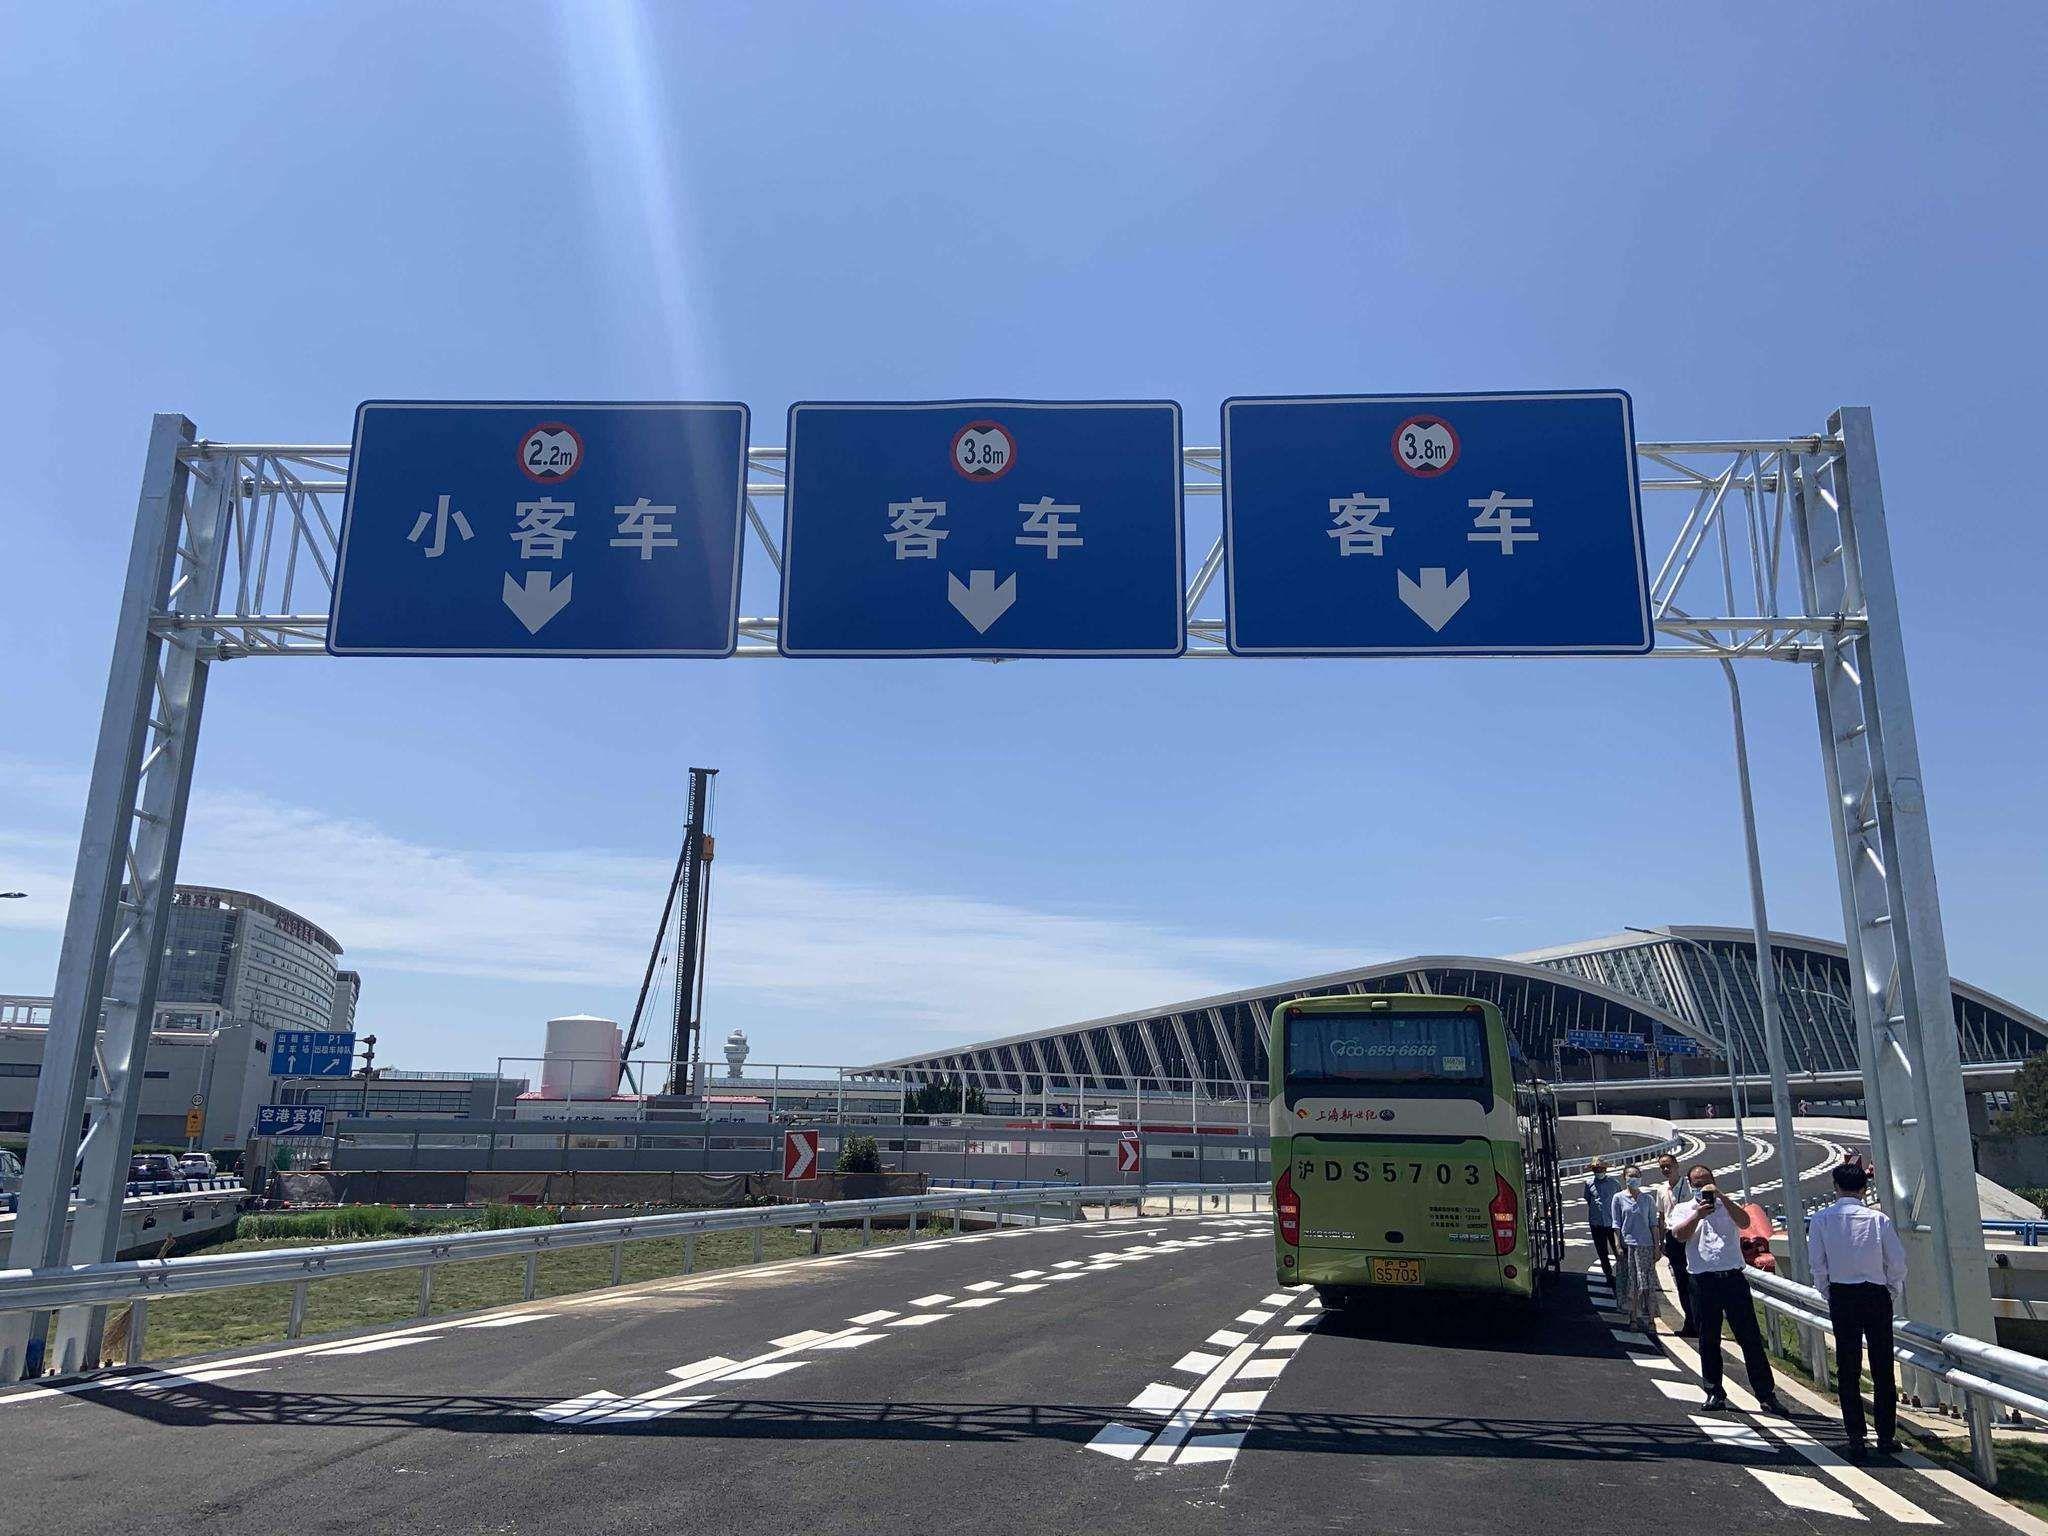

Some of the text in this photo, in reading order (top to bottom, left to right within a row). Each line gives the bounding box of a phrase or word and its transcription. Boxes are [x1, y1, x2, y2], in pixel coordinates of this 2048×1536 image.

[528, 439, 573, 466] 2.2m
[964, 438, 1004, 465] 3.8m
[1404, 433, 1447, 460] 3.8m
[328, 1034, 341, 1045] P1
[261, 1108, 324, 1123] 空港宾馆
[1298, 1160, 1482, 1185] 沪DS5703
[1376, 1267, 1418, 1282] S5703
